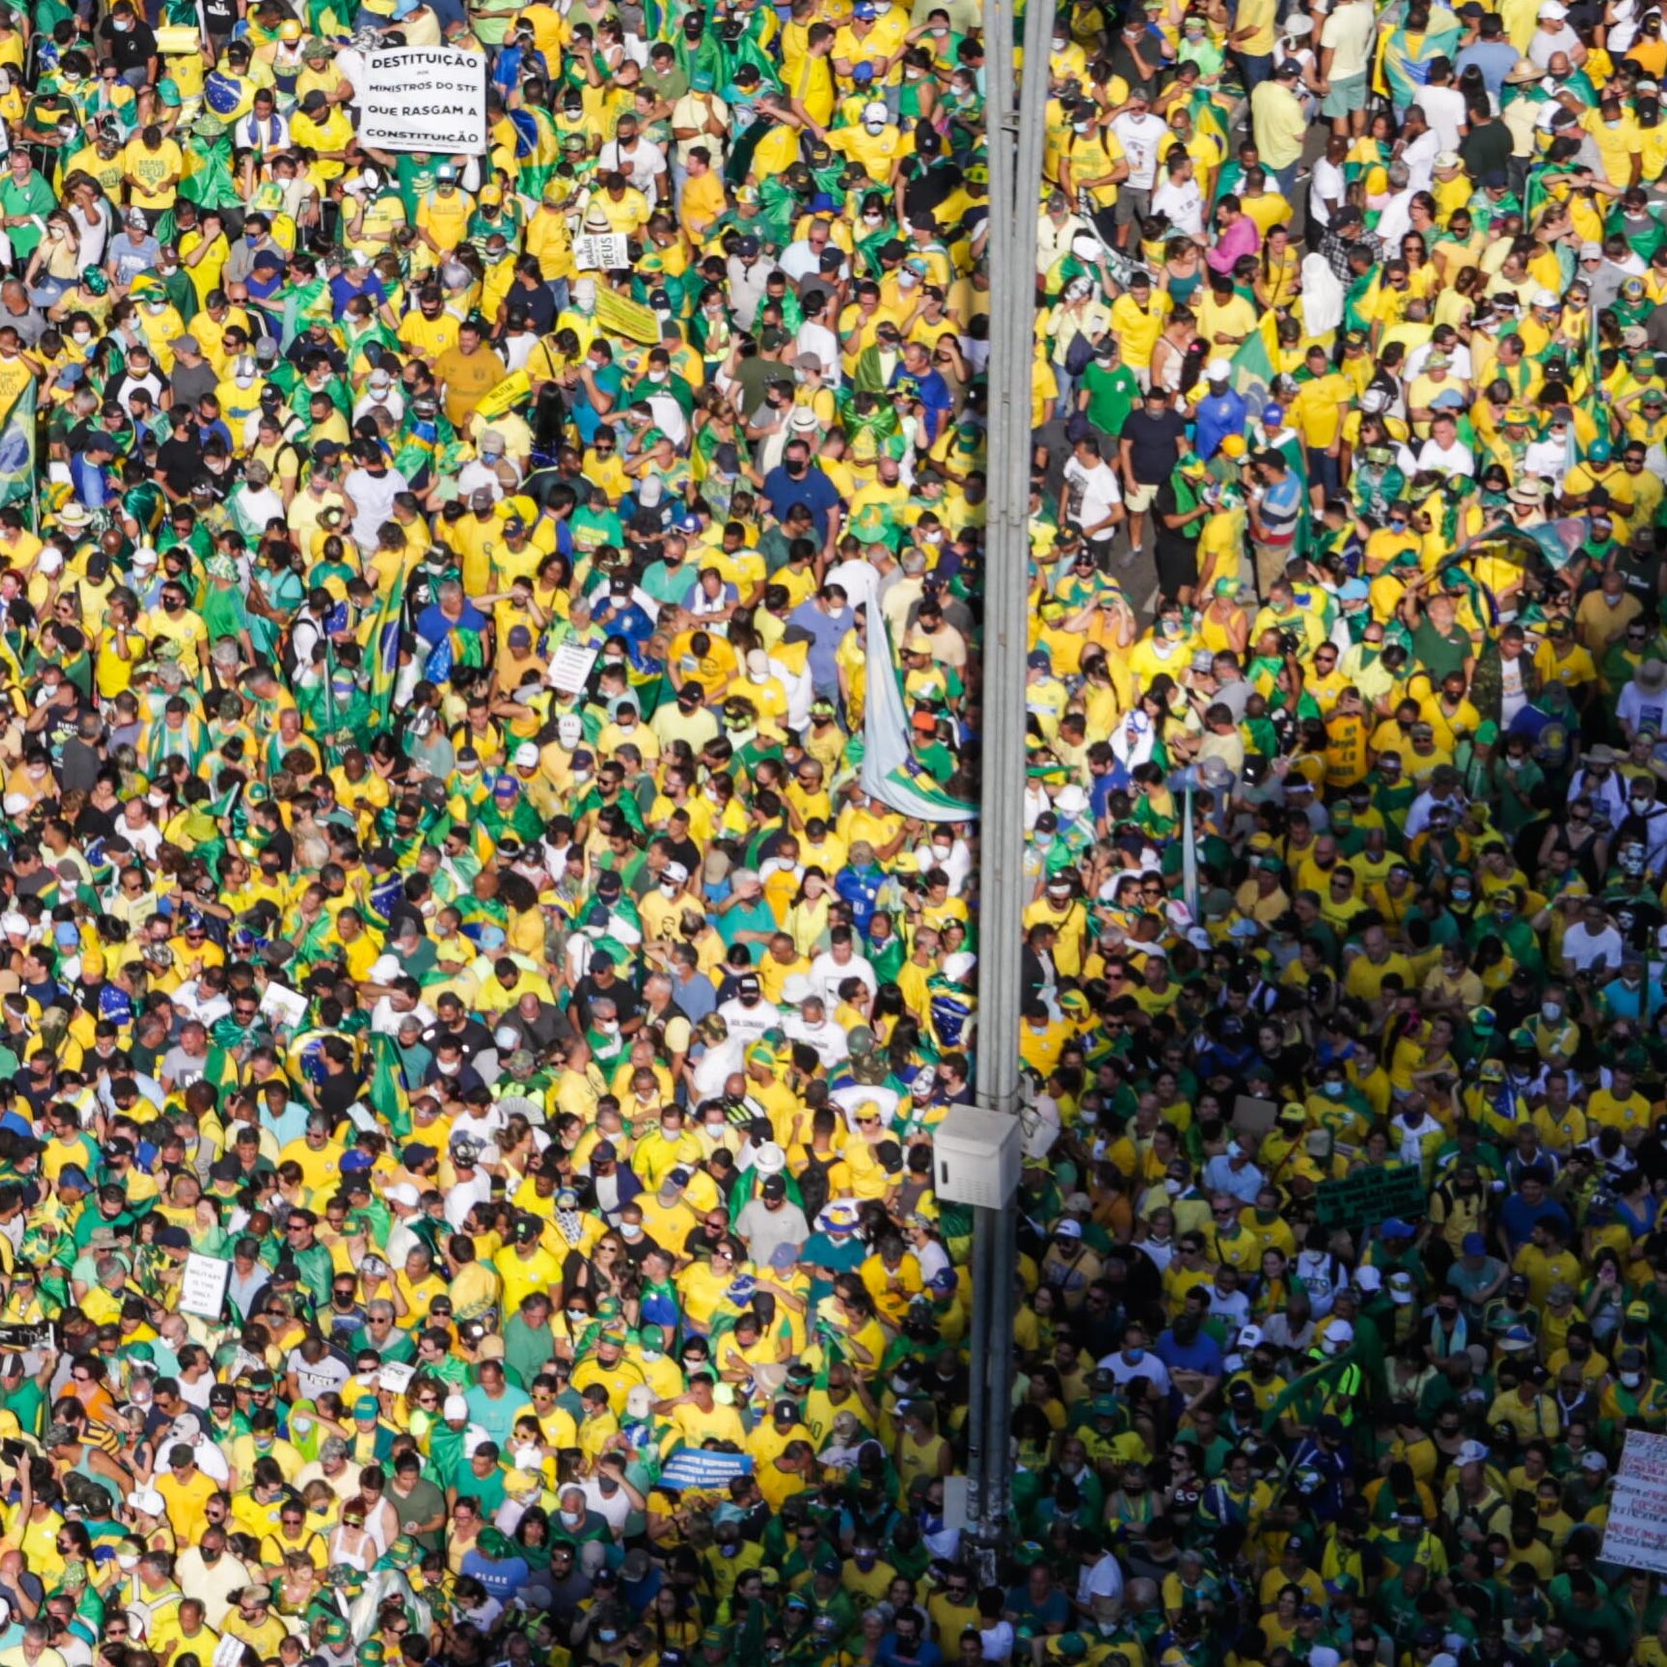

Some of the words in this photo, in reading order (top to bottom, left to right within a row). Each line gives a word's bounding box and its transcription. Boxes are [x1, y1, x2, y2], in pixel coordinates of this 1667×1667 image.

[372, 53, 478, 69] DESTITUIÇÃO
[369, 81, 432, 92] MINISTROS
[436, 82, 454, 91] DO
[457, 83, 479, 93] STF
[368, 105, 398, 116] QUE
[402, 105, 464, 116] RASGAM
[468, 107, 478, 117] A
[366, 128, 479, 143] CONSTITUIÇÃO
[584, 237, 594, 267] BRASIL
[601, 237, 613, 267] DEUS
[489, 382, 514, 400] MILITAR
[189, 1268, 222, 1280] MILITARY
